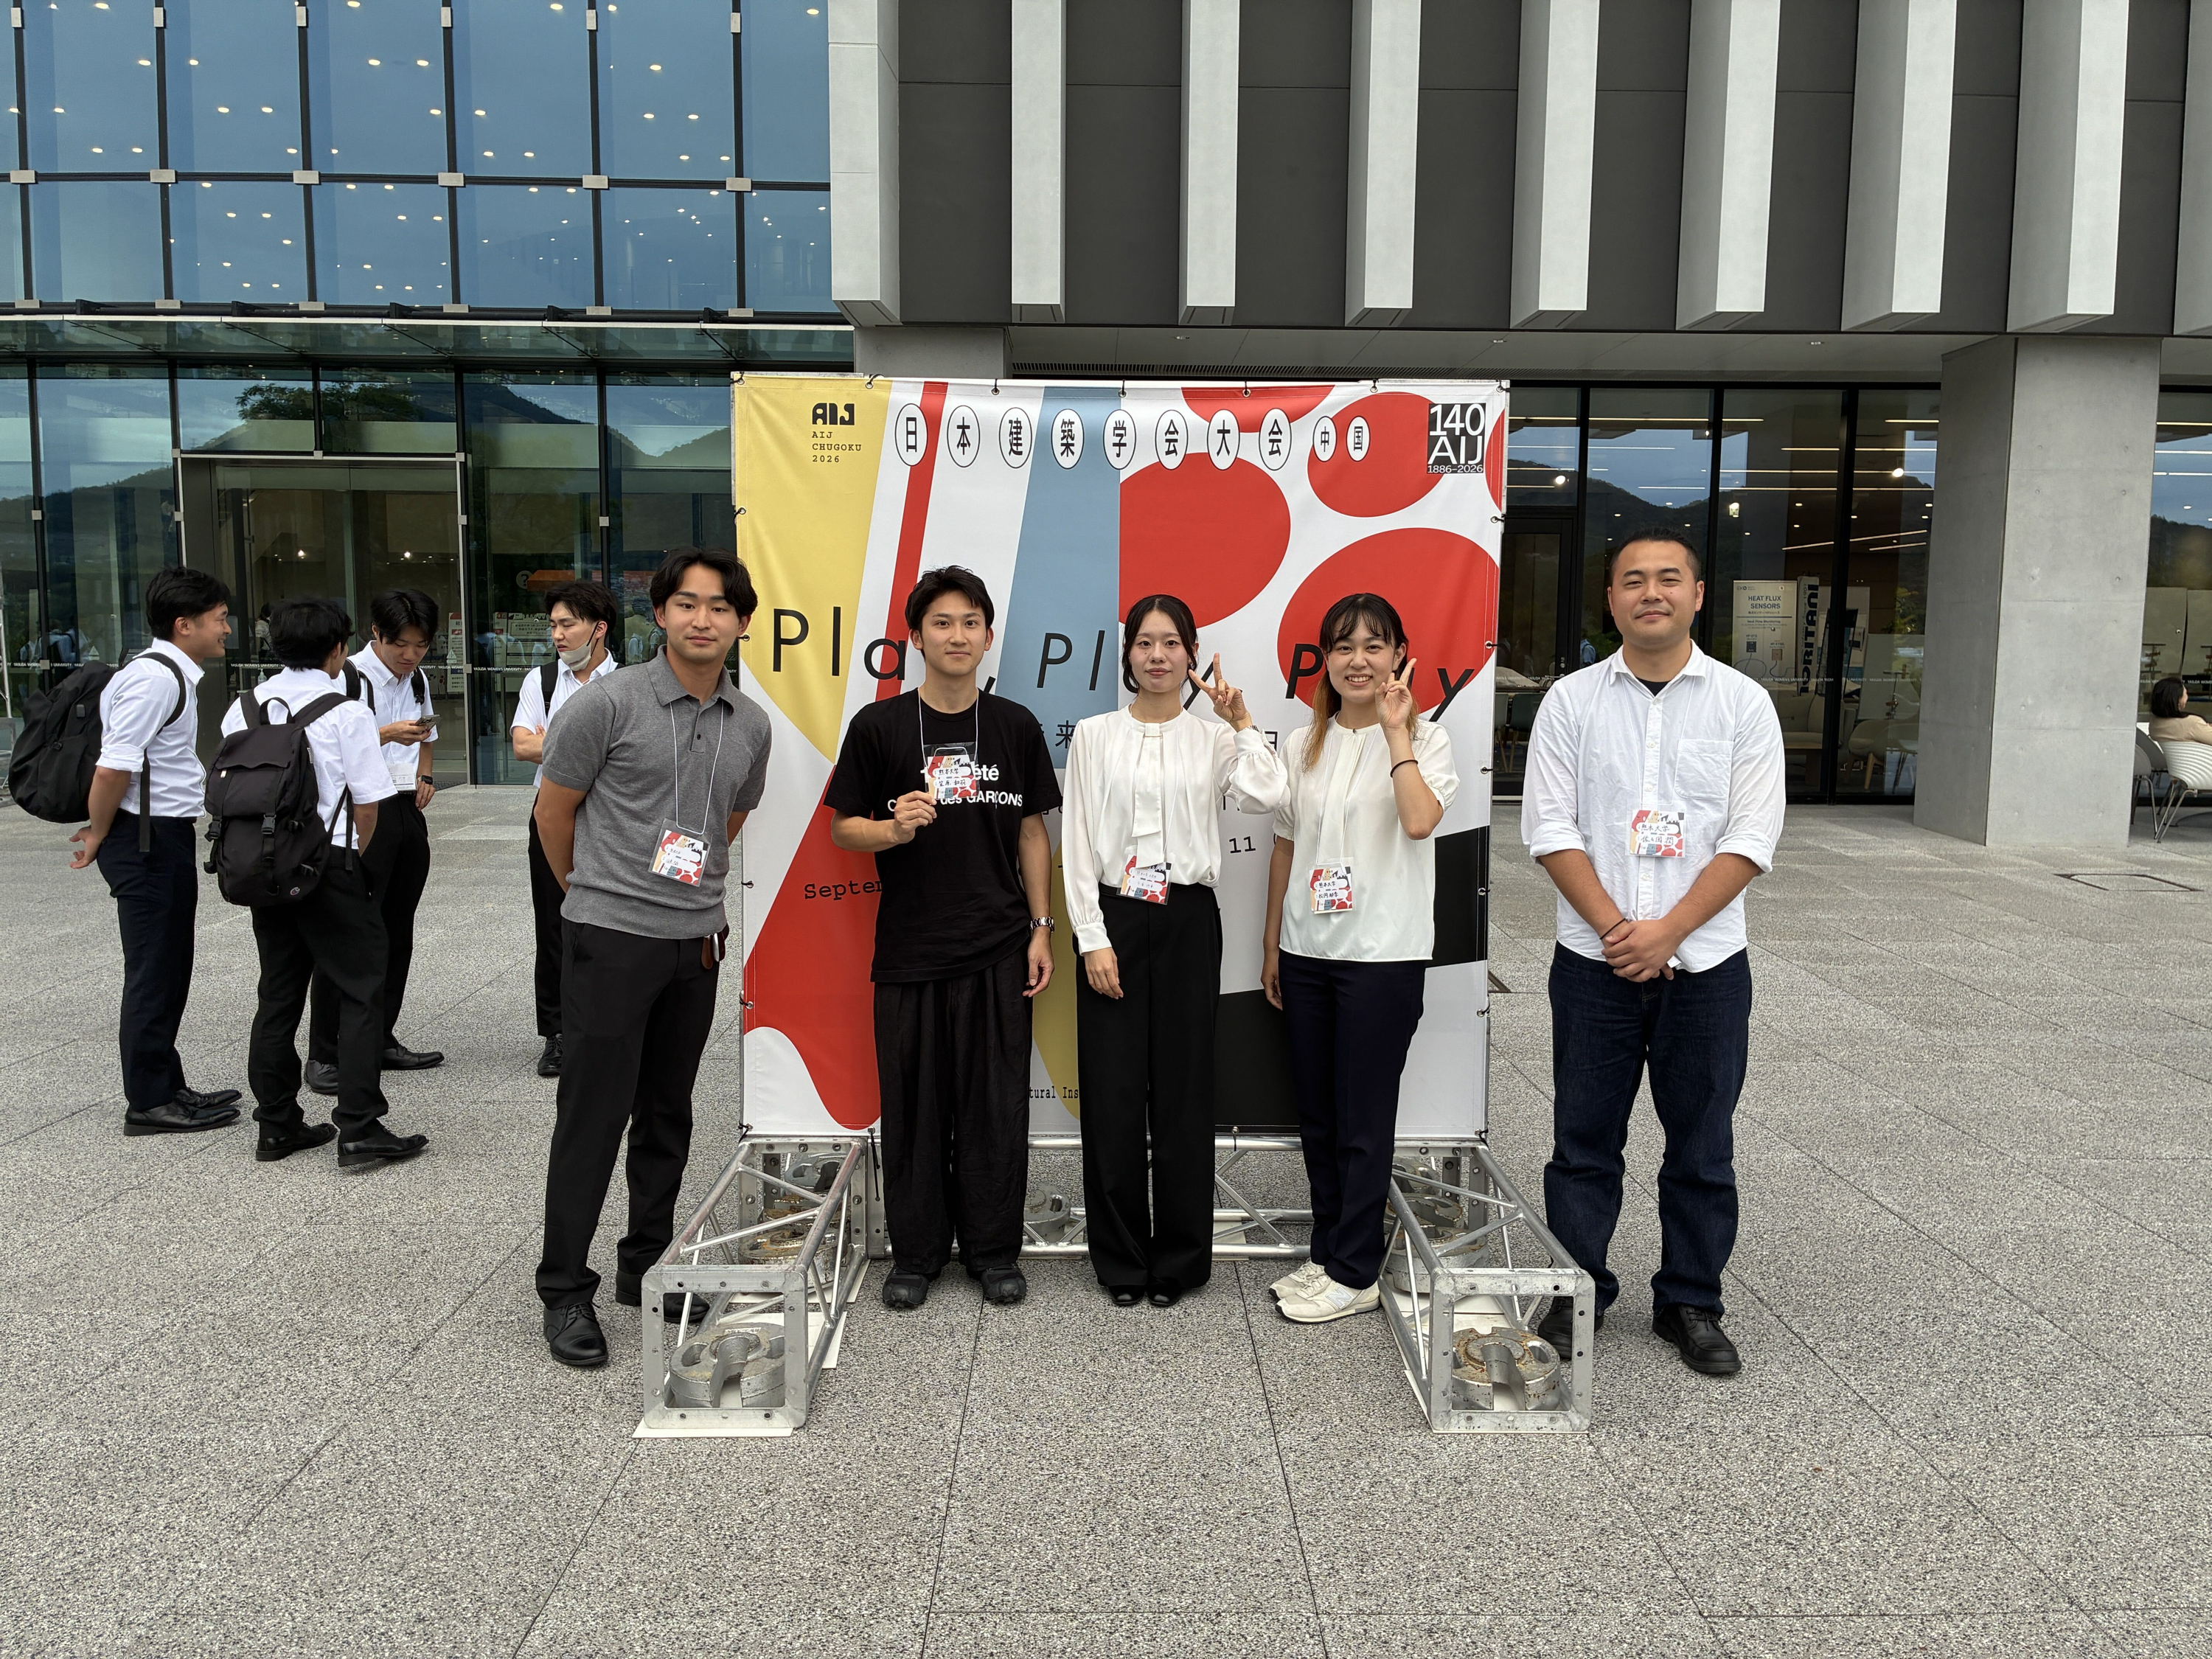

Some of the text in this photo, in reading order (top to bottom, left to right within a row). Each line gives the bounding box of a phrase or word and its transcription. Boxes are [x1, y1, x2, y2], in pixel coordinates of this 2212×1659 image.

[812, 403, 855, 425] AIJ
[1430, 403, 1485, 436] 140
[812, 443, 862, 451] CHUGOKU
[1427, 436, 1483, 465] AIJ
[813, 455, 839, 463] 2026
[1228, 835, 1256, 854] 11
